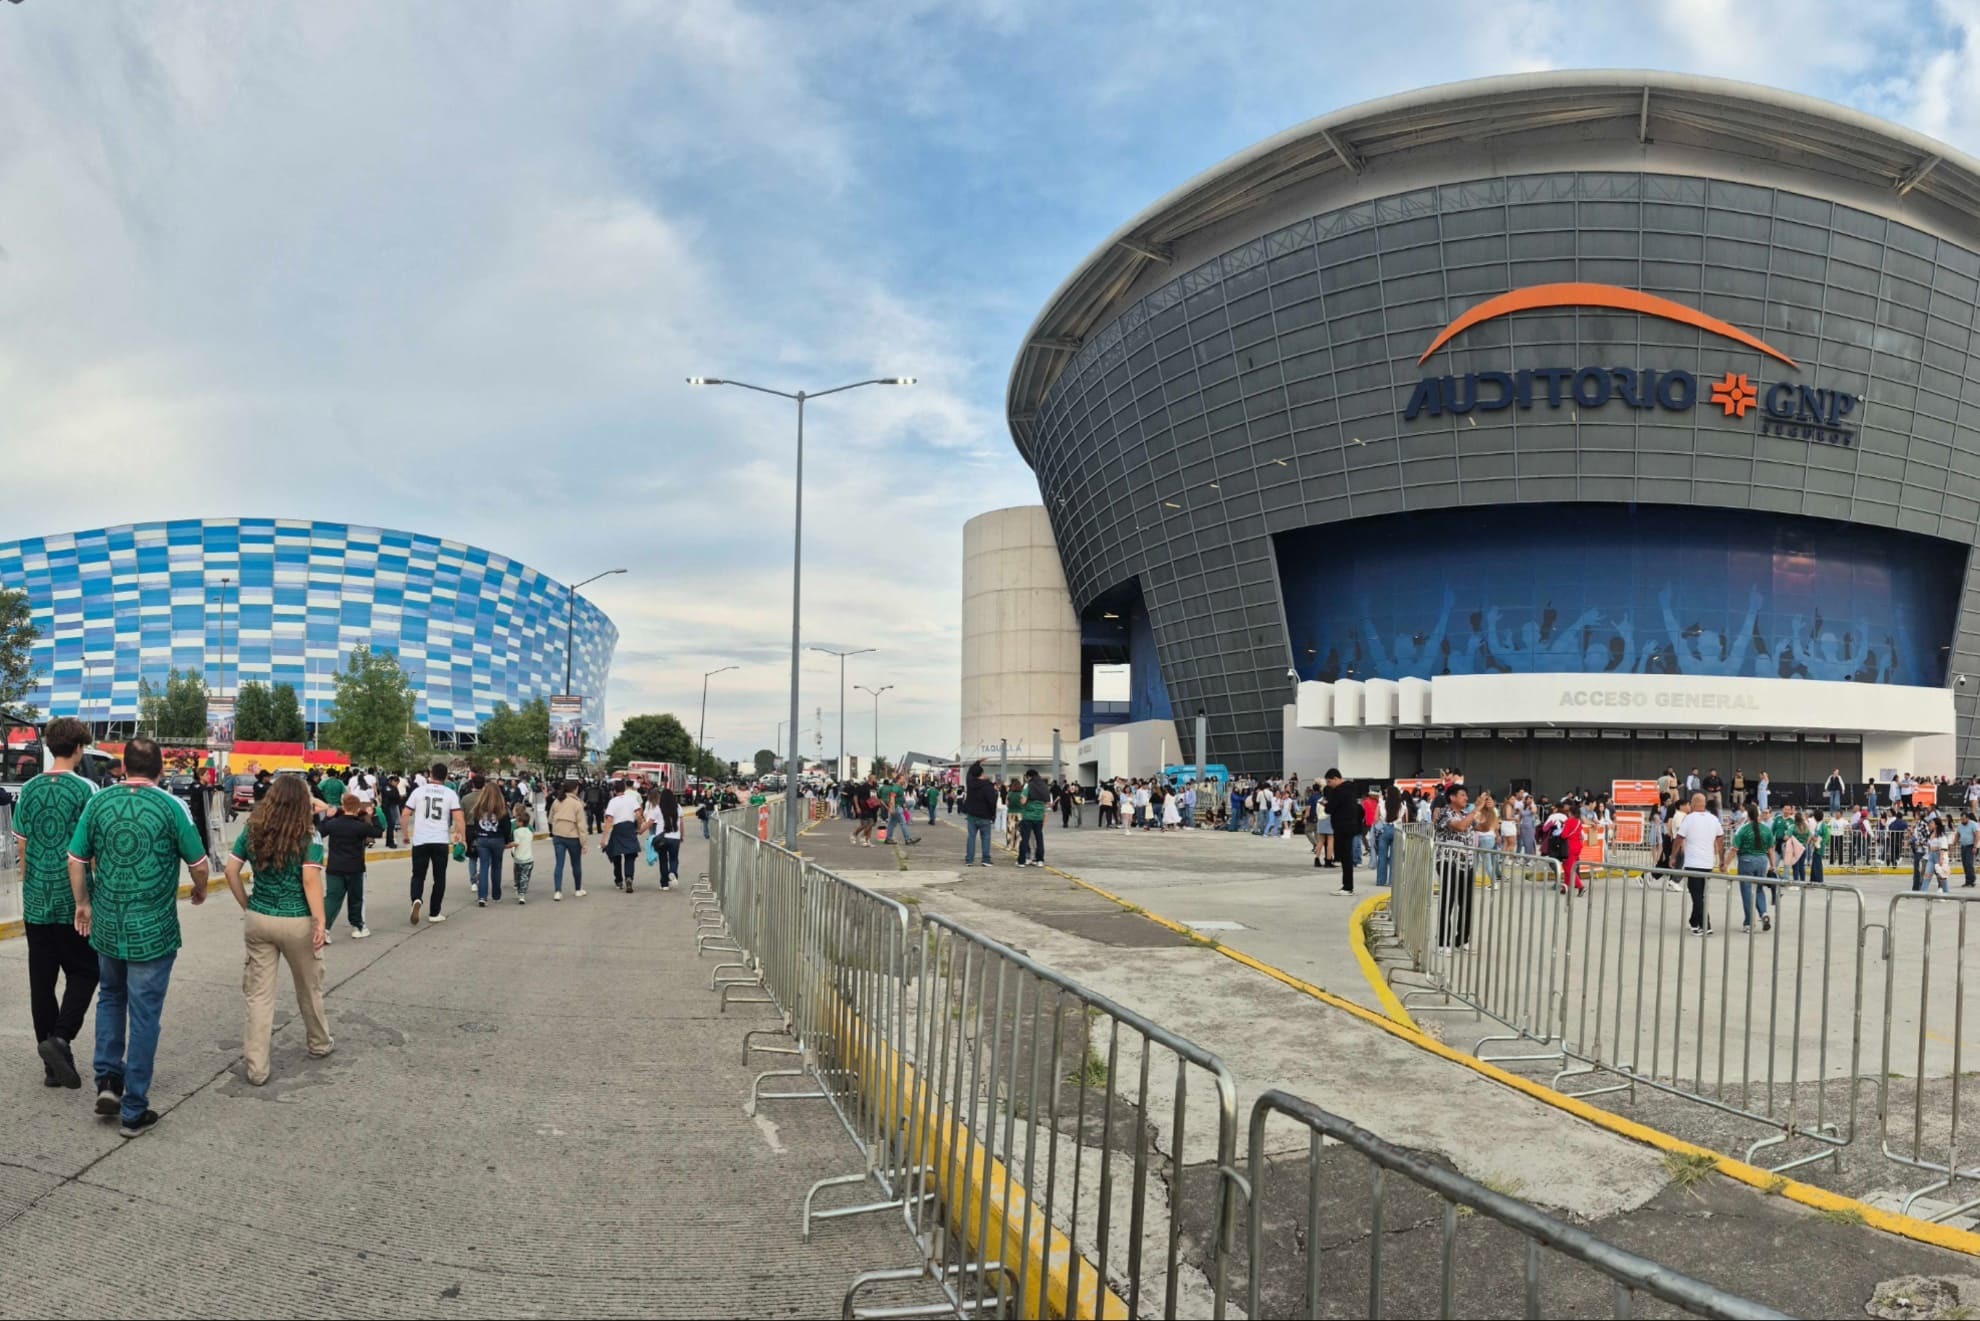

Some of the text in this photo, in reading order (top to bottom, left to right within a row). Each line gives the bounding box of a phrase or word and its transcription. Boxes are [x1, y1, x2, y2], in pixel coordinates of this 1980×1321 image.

[1404, 367, 1856, 425] AUDITORIO GNP
[1560, 690, 1759, 710] ACCESO GENERAL
[424, 796, 443, 820] 15
